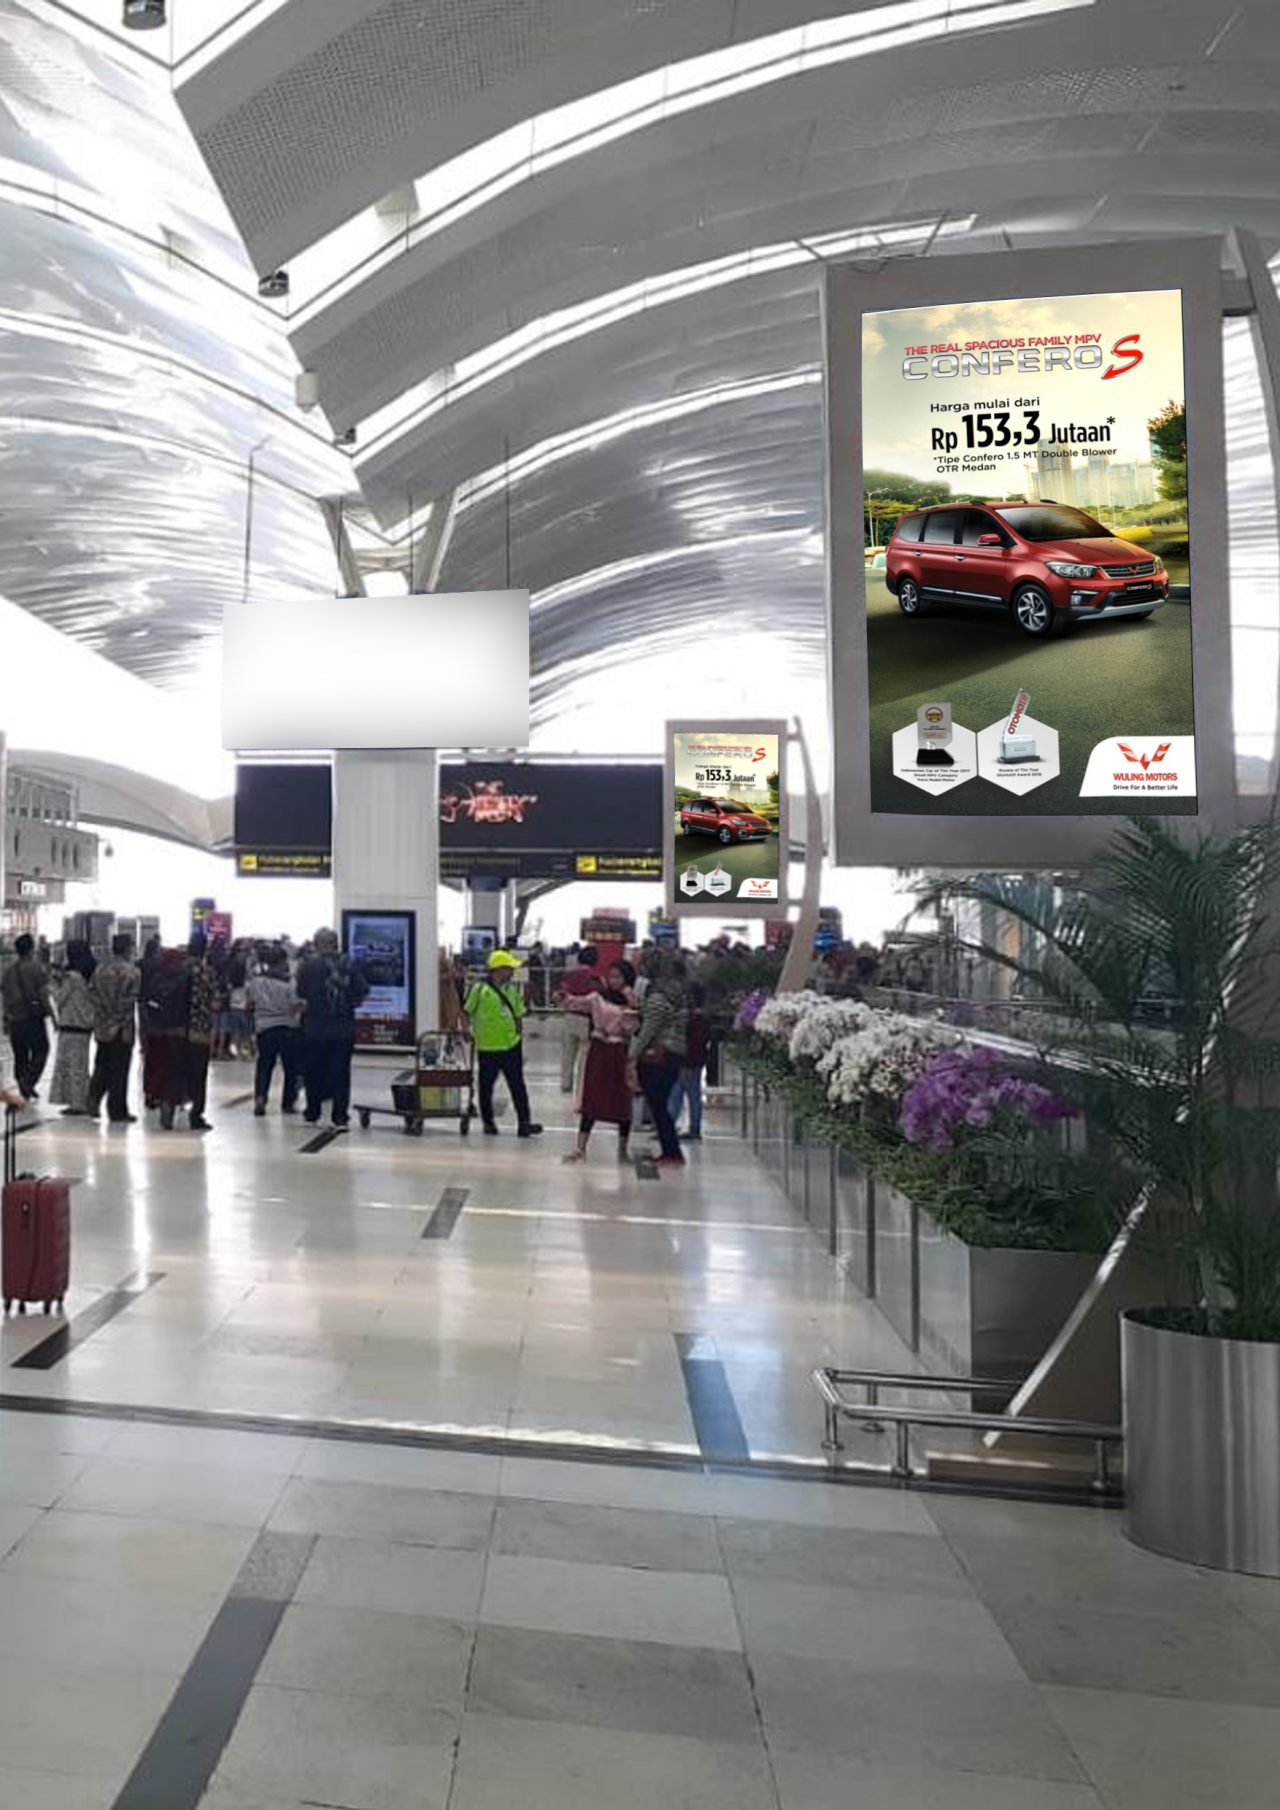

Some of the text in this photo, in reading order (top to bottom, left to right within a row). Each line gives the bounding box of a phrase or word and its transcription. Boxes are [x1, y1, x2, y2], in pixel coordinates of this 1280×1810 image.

[904, 333, 1102, 356] THE REAL SPACIOUS FAMILY MPV
[902, 334, 1144, 381] CONFERO S
[930, 396, 1040, 413] Harga mulai dari
[931, 427, 958, 453] Rp
[961, 410, 1040, 448] 153,3
[963, 453, 1004, 463] Confero
[1006, 452, 1020, 461] 1.5
[1023, 451, 1039, 459] MT
[1041, 448, 1079, 459] Double
[1082, 447, 1117, 457] Blower
[936, 463, 996, 474] OTR Medan
[752, 747, 766, 762] S
[695, 772, 705, 782] Rp
[705, 769, 731, 782] 153,3
[1113, 773, 1178, 781] WULING MOTORS
